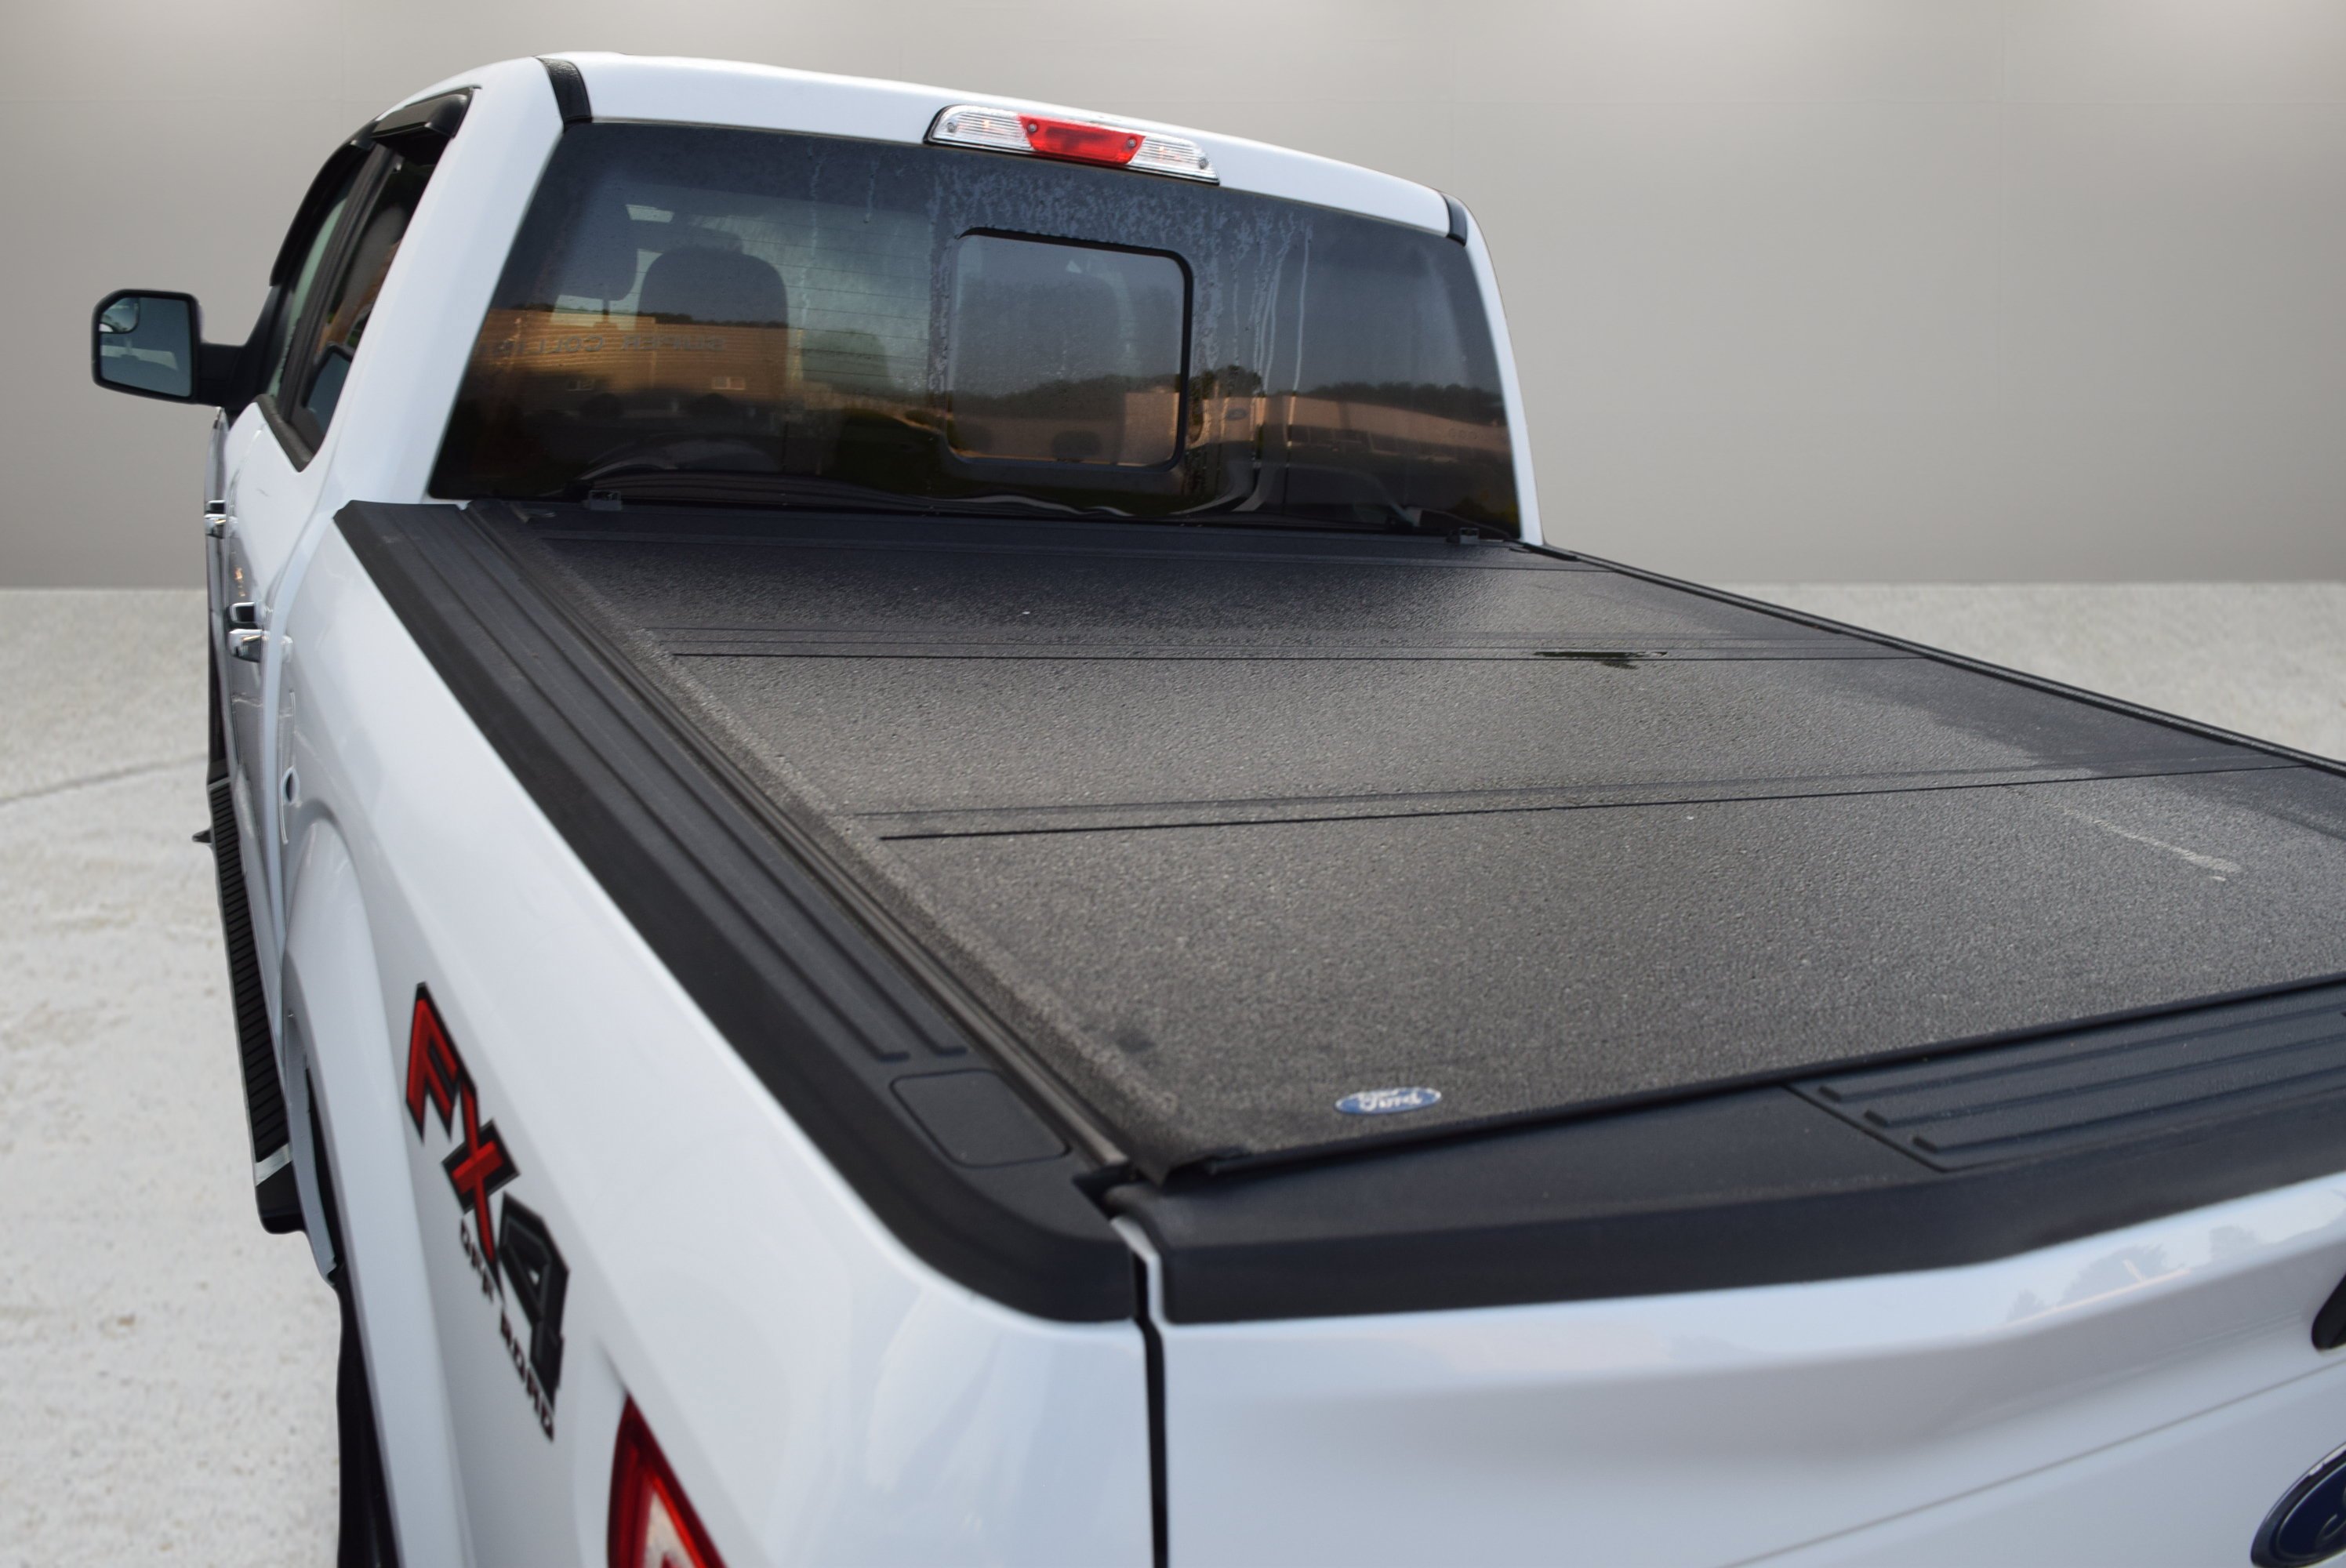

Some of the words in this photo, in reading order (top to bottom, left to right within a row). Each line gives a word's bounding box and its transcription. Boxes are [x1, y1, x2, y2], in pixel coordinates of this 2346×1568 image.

[406, 981, 570, 1410] FX4
[459, 1217, 494, 1305] OFF
[499, 1306, 554, 1442] ROAD
